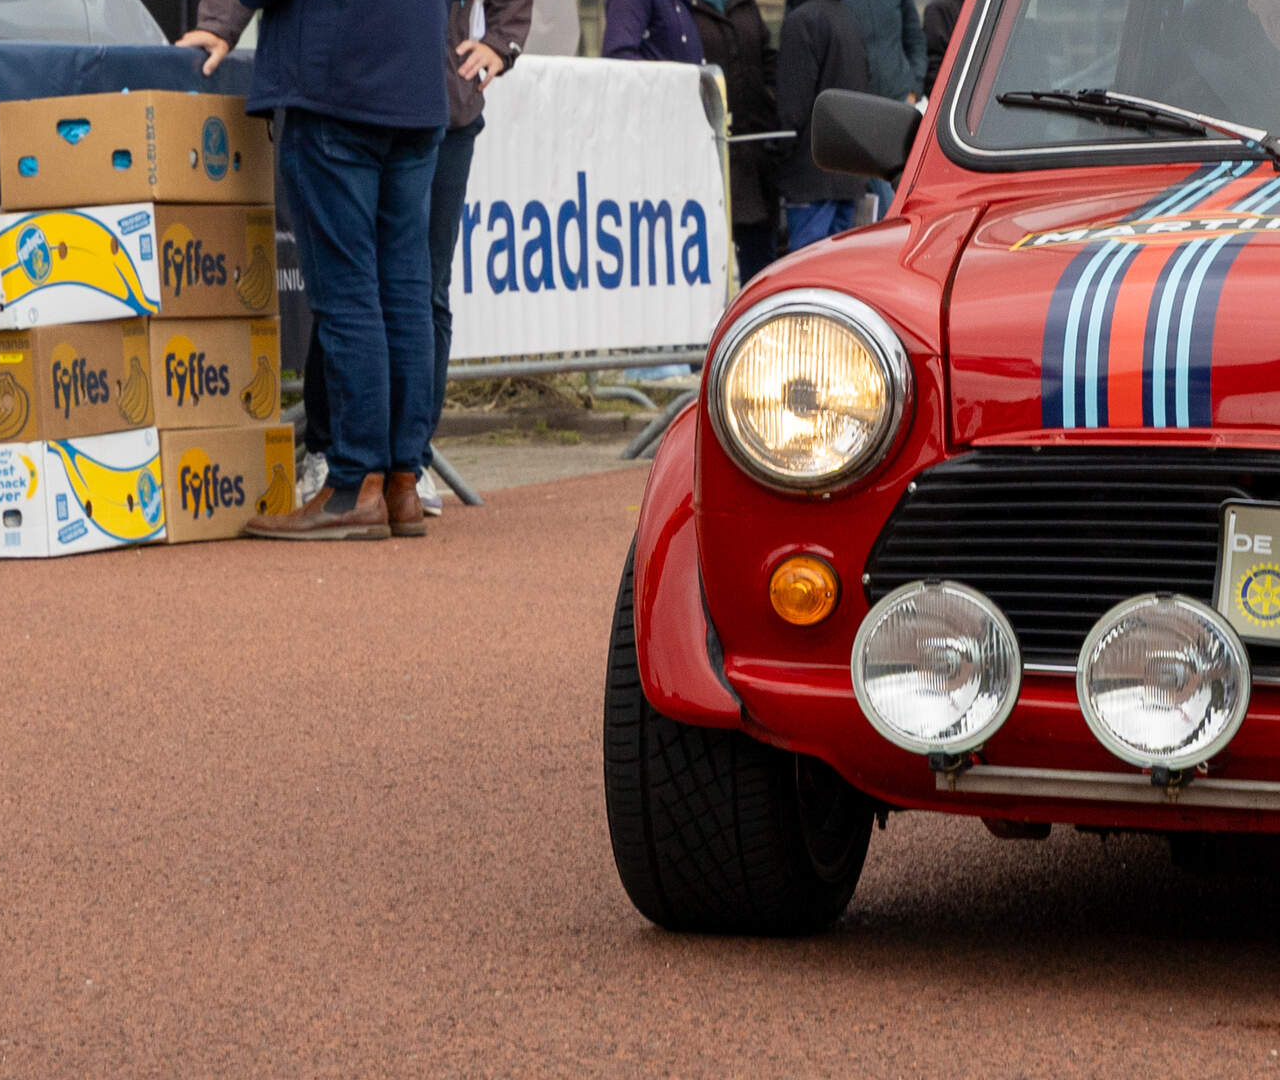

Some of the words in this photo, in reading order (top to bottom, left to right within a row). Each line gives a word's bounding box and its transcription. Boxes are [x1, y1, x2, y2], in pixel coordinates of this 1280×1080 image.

[165, 352, 230, 407] fyffes
[181, 463, 245, 520] fyffes
[1231, 534, 1273, 556] DE
